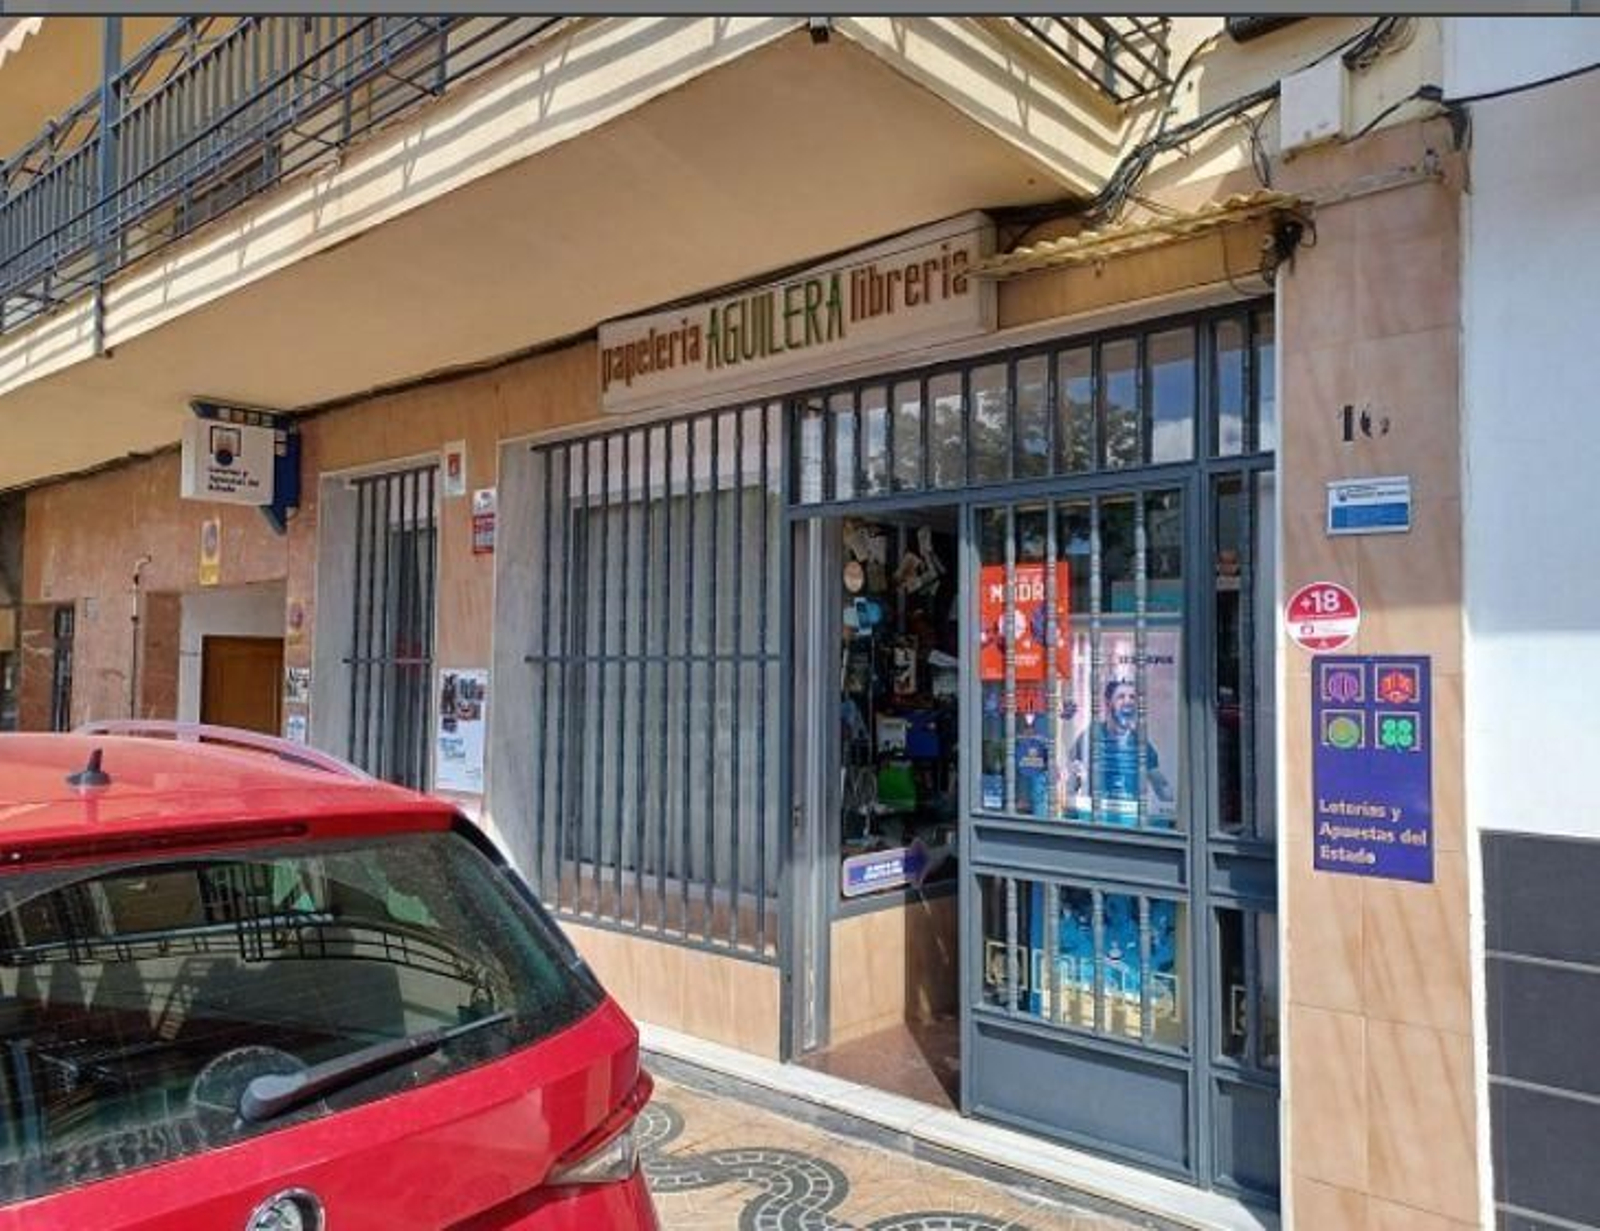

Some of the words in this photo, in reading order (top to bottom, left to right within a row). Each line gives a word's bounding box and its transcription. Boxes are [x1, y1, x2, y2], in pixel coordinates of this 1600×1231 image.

[706, 273, 844, 370] AGUILERA
[850, 243, 969, 323] libreria
[1300, 589, 1341, 614] +18
[1391, 807, 1402, 822] y
[1399, 829, 1427, 847] del
[1320, 844, 1376, 864] Estado
